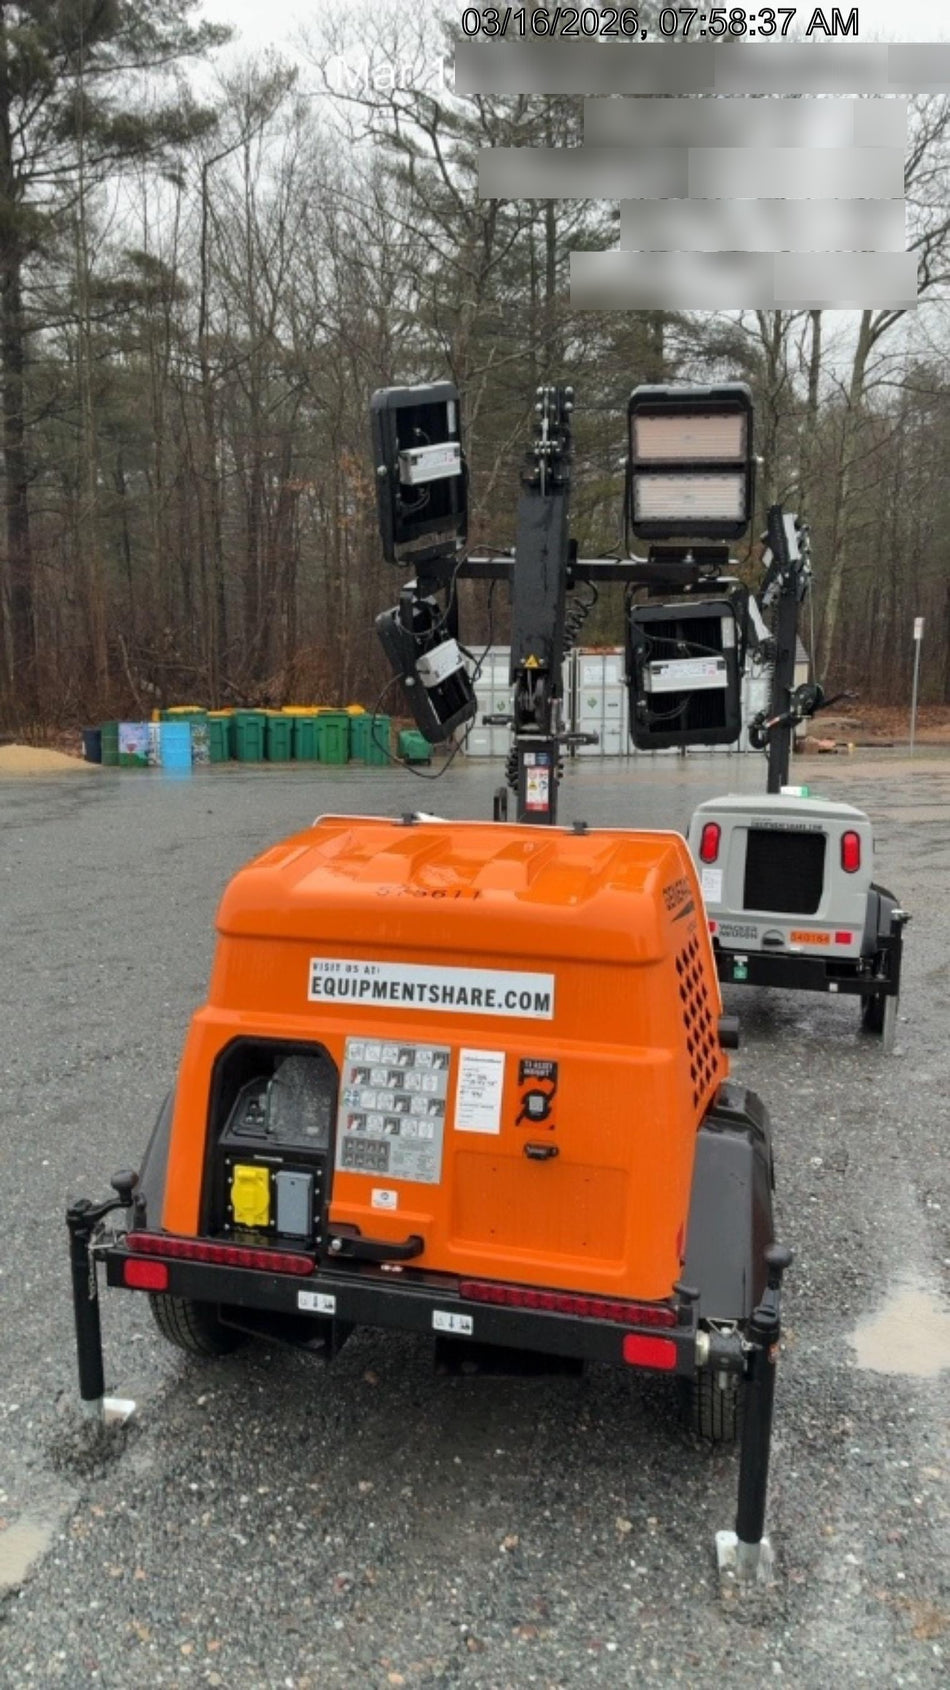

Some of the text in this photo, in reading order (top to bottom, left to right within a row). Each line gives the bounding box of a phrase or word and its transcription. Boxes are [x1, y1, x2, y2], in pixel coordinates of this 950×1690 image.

[313, 963, 341, 972] VISIT
[345, 964, 359, 973] US
[311, 975, 551, 1013] EQUIPMENTSHARE.COM
